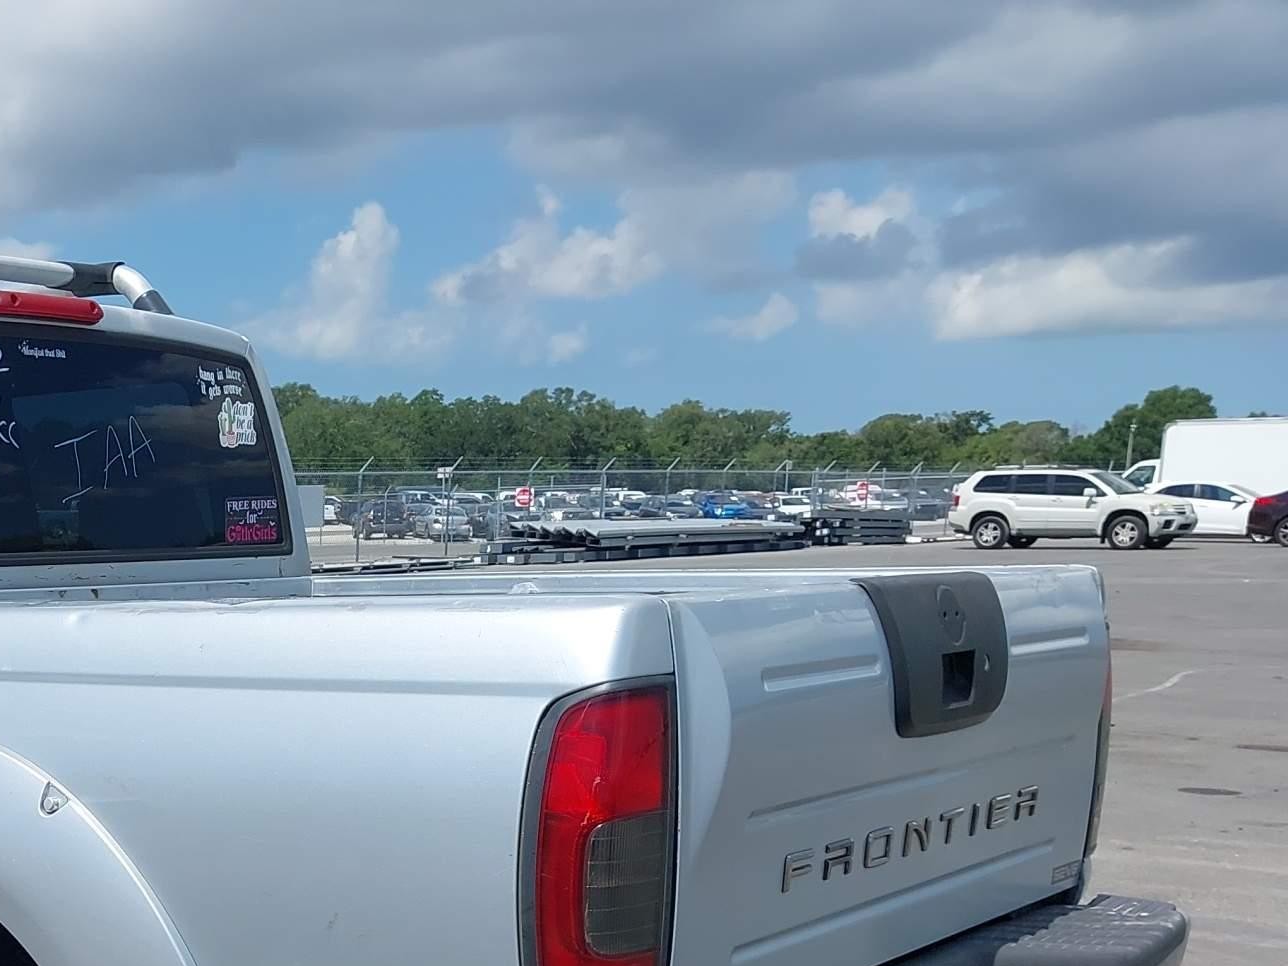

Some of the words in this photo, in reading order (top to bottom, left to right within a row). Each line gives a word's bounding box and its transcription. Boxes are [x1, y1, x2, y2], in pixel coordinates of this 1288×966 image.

[54, 415, 155, 503] IAA
[227, 500, 250, 512] FREE
[251, 499, 278, 511] RIDES
[246, 510, 257, 523] for
[782, 785, 1039, 893] FRONTIER
